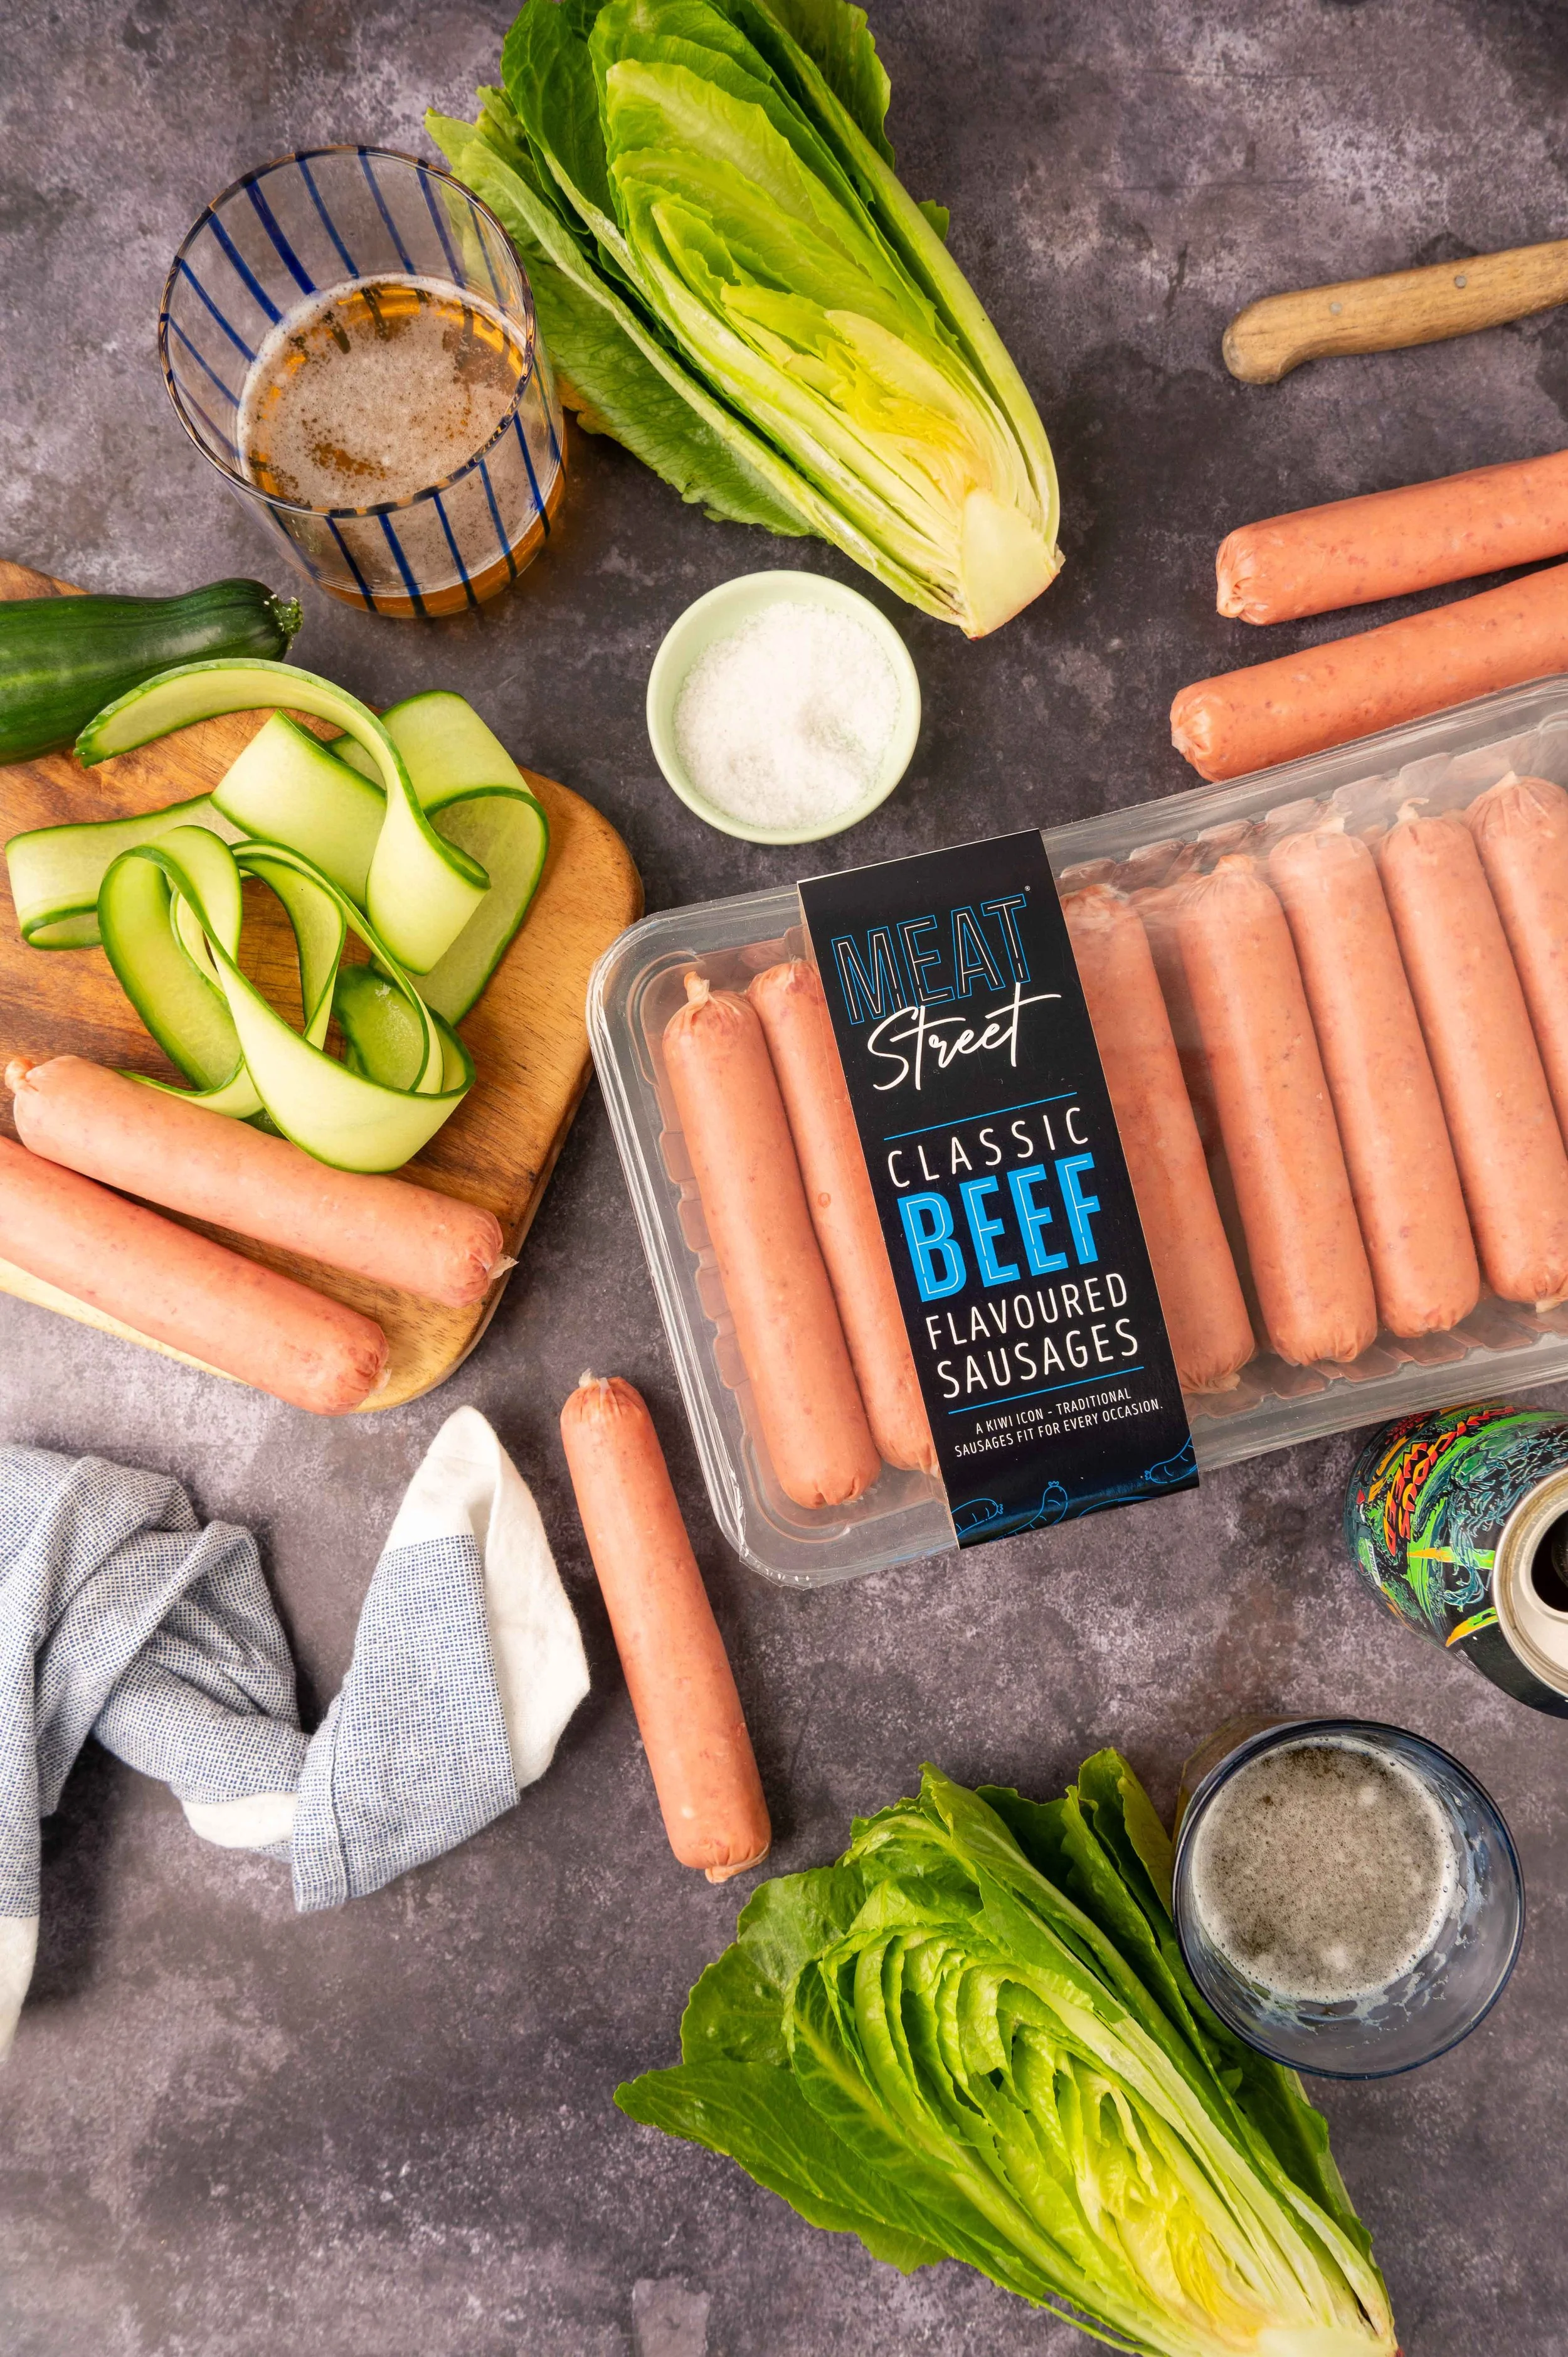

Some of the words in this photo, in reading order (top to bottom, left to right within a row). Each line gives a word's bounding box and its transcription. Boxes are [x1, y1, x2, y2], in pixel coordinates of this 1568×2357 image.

[831, 893, 1030, 1024] MEAT
[867, 982, 1062, 1090] Street
[888, 1107, 1088, 1187] CLASSIC
[897, 1152, 1101, 1302] BEEF
[926, 1274, 1126, 1349] FLAVOURED
[938, 1319, 1137, 1398] SAUSAGES
[955, 1433, 1014, 1457] SAUSAGES
[1016, 1428, 1034, 1443] FIT
[1037, 1422, 1061, 1438] FOR
[1063, 1412, 1098, 1432] EVERY
[1103, 1399, 1163, 1422] OCCASION.
[976, 1422, 983, 1435] A
[985, 1415, 1013, 1432] KIWI
[1015, 1408, 1044, 1425] ICON
[1055, 1388, 1131, 1415] TRADITIONAL
